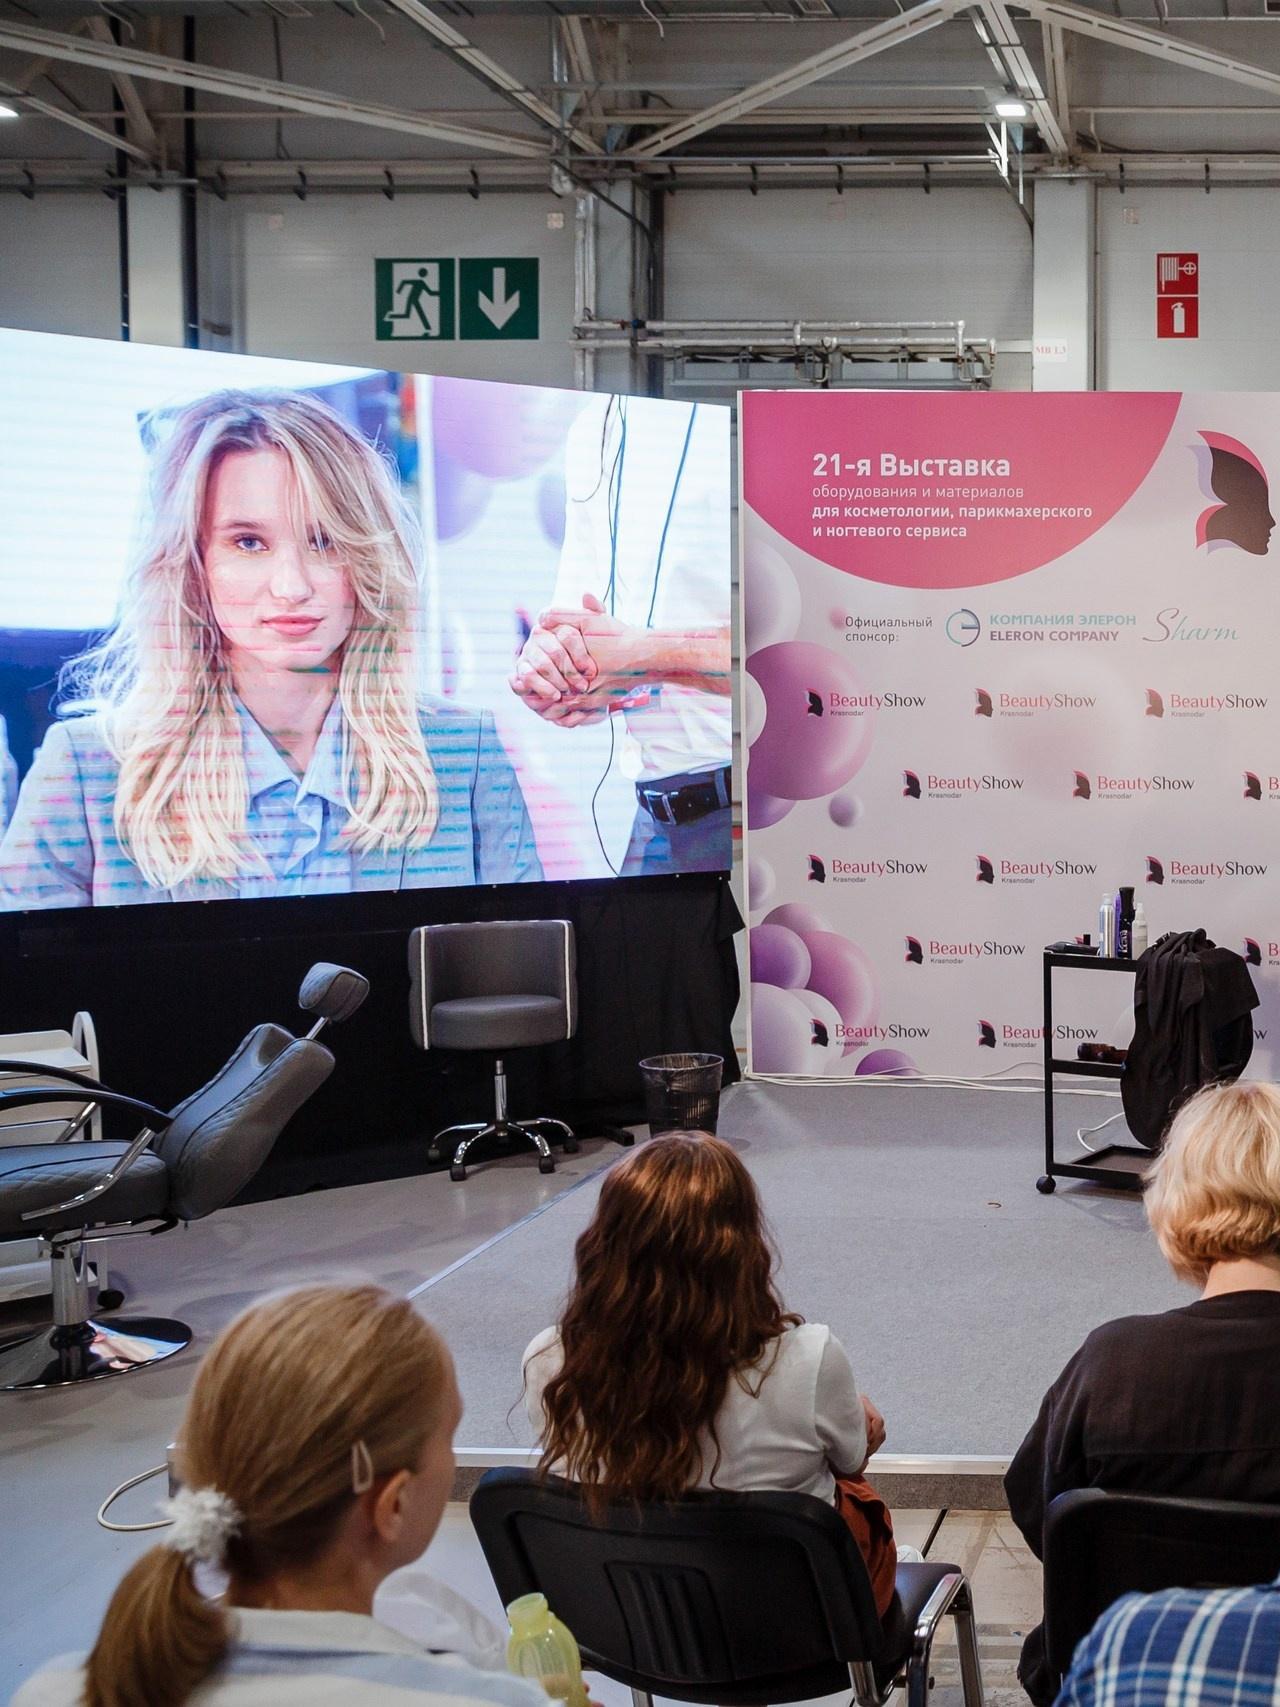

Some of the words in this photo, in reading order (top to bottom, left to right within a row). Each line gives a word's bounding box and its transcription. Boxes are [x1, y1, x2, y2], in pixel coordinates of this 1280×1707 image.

[812, 453, 871, 477] 21-я
[880, 454, 1011, 478] Выставка
[812, 485, 918, 500] оборудования
[922, 488, 931, 498] и
[935, 488, 1024, 501] материалов
[812, 506, 840, 519] для
[844, 505, 954, 520] косметологии,
[959, 506, 1093, 521] парикмахерского
[812, 526, 823, 537] и
[825, 525, 903, 538] ногтевого
[905, 526, 968, 540] сервиса
[845, 615, 933, 630] Официальный
[990, 614, 1074, 626] КОМПАНИЯ
[1079, 614, 1137, 626] ЭЛЕРОН
[1142, 607, 1240, 643] Sharm
[845, 632, 900, 644] спонсор:
[990, 630, 1044, 641] ELERON
[1049, 630, 1120, 642] COMPANY
[830, 693, 926, 710] BeautyShow
[999, 693, 1095, 710] BeautyShow
[1171, 694, 1267, 711] BeautyShow
[928, 775, 1024, 792] BeautyShow
[1097, 776, 1193, 793] BeautyShow
[832, 860, 928, 877] BeautyShow
[1000, 860, 1096, 877] BeautyShow
[1171, 861, 1267, 878] BeautyShow
[930, 941, 1026, 958] BeautyShow
[835, 1024, 931, 1041] BeautyShow
